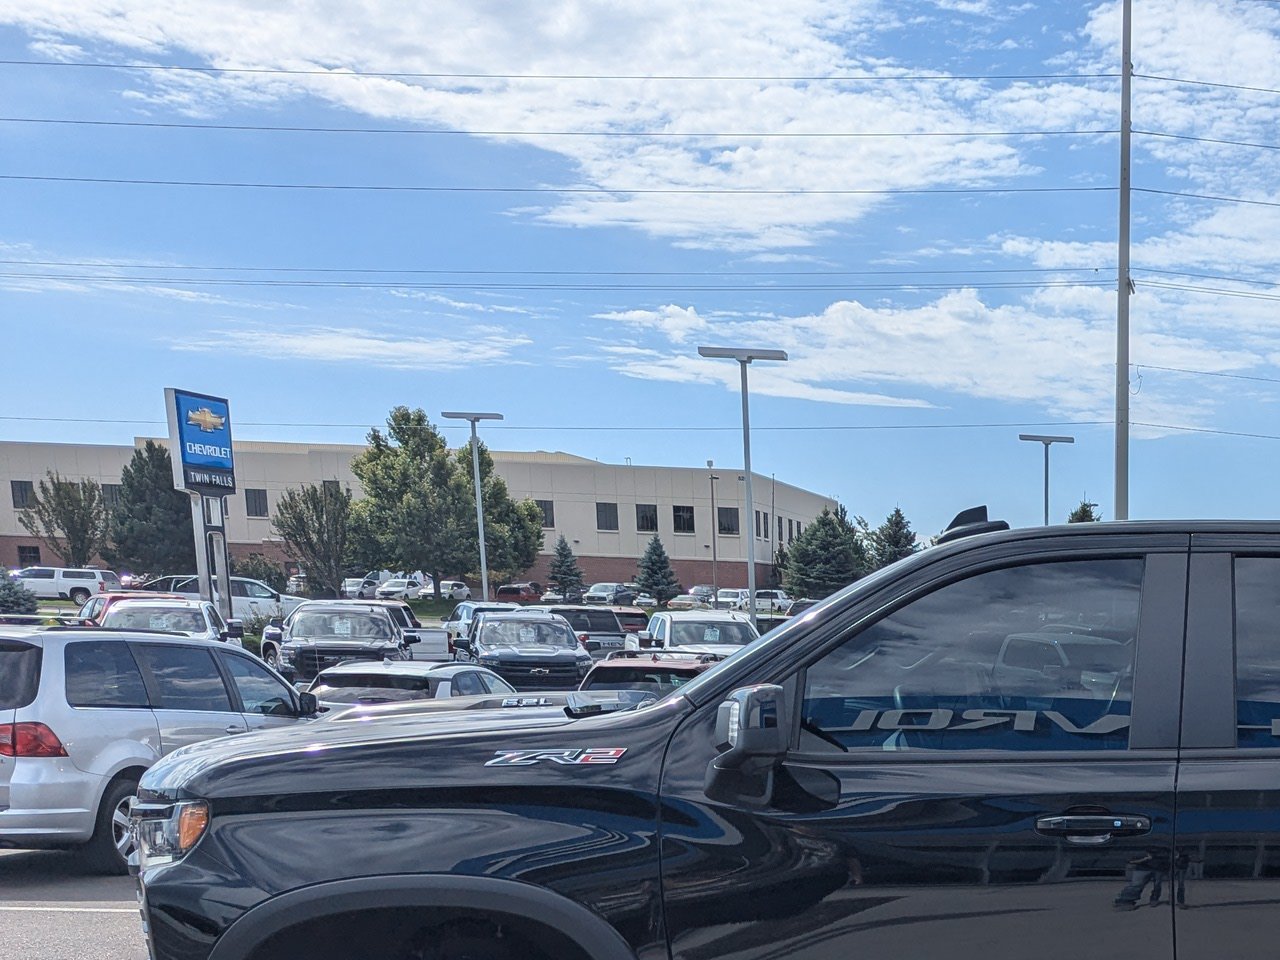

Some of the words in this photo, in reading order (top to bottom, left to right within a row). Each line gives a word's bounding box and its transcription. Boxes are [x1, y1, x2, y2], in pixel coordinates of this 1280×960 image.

[187, 442, 231, 459] CHEVROLET
[190, 471, 210, 484] TWIN
[211, 474, 233, 487] FALLS
[484, 747, 628, 767] ZR2
